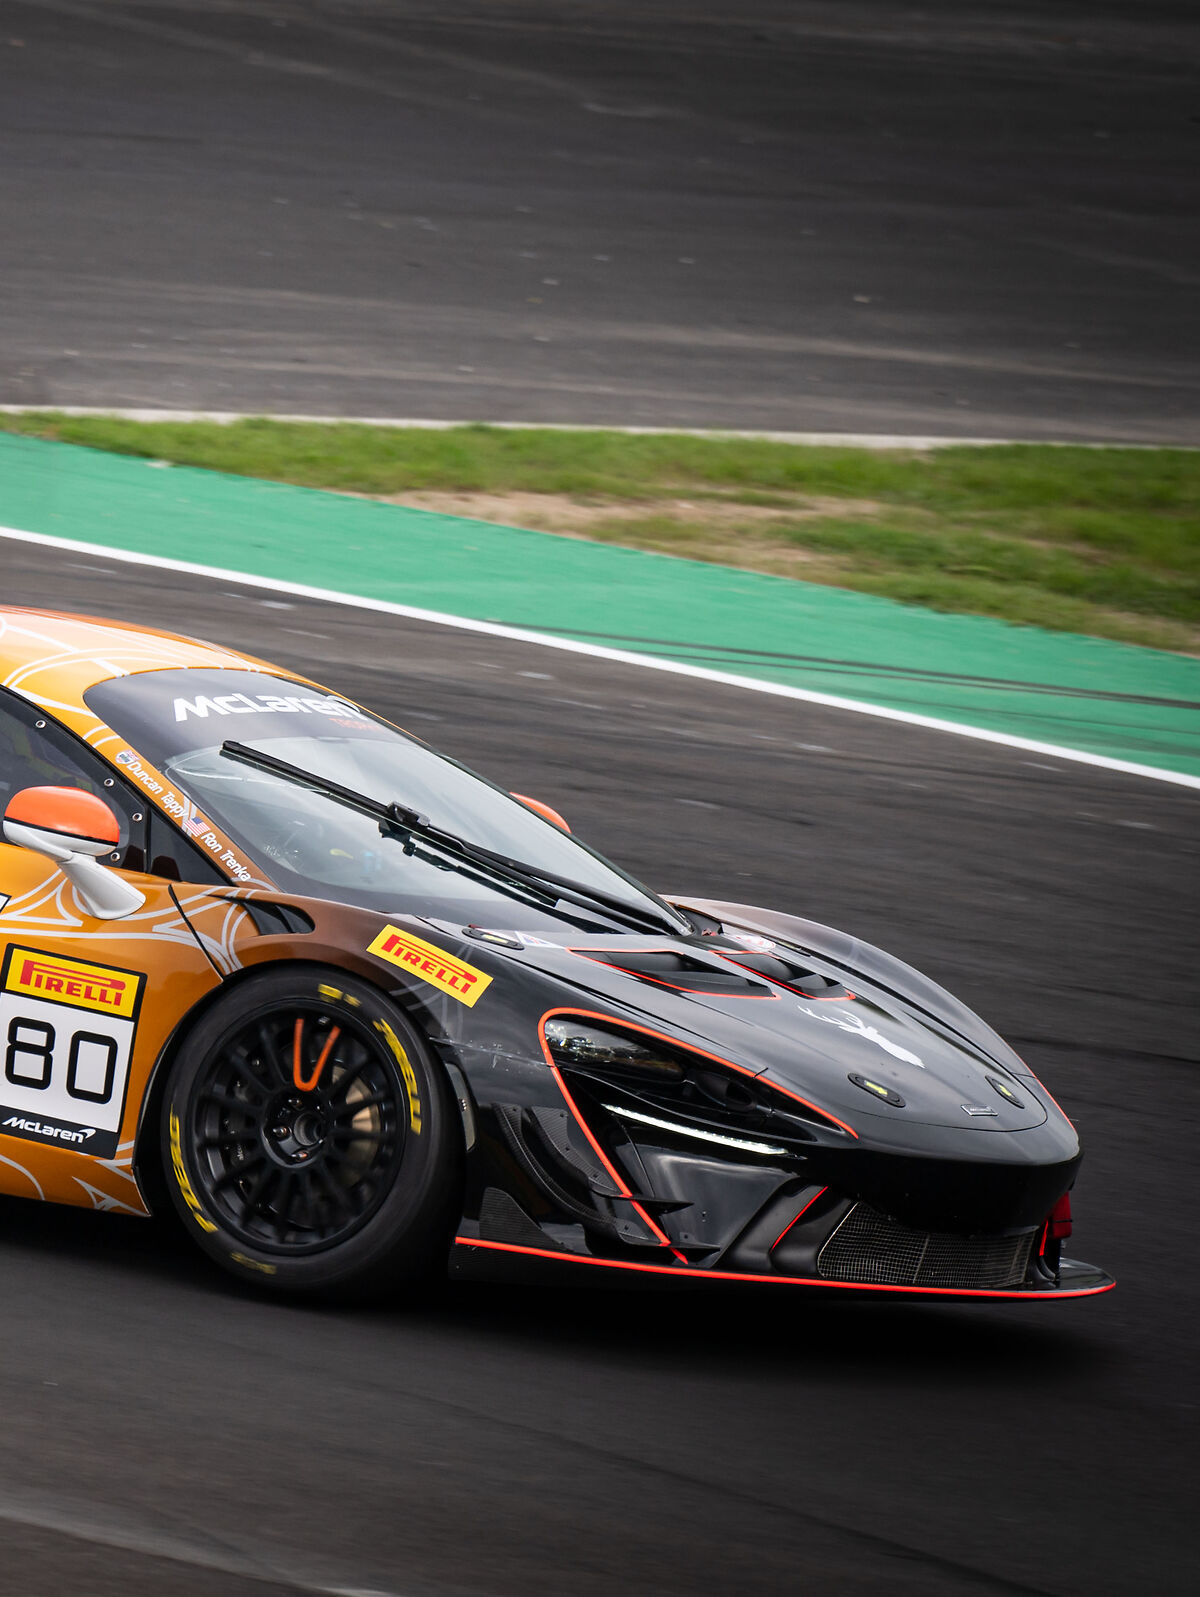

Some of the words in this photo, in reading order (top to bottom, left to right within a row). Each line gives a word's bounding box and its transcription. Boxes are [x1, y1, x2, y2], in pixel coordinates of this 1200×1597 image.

[173, 692, 369, 722] McLaren
[125, 760, 163, 795] Duncan
[160, 791, 189, 818] Tappy
[200, 832, 223, 853] Ron
[220, 849, 252, 882] Trenka
[19, 959, 126, 1007] PIRELLI
[381, 933, 478, 995] PIRELLI
[5, 1016, 119, 1105] 80
[1, 1115, 86, 1144] McLaren
